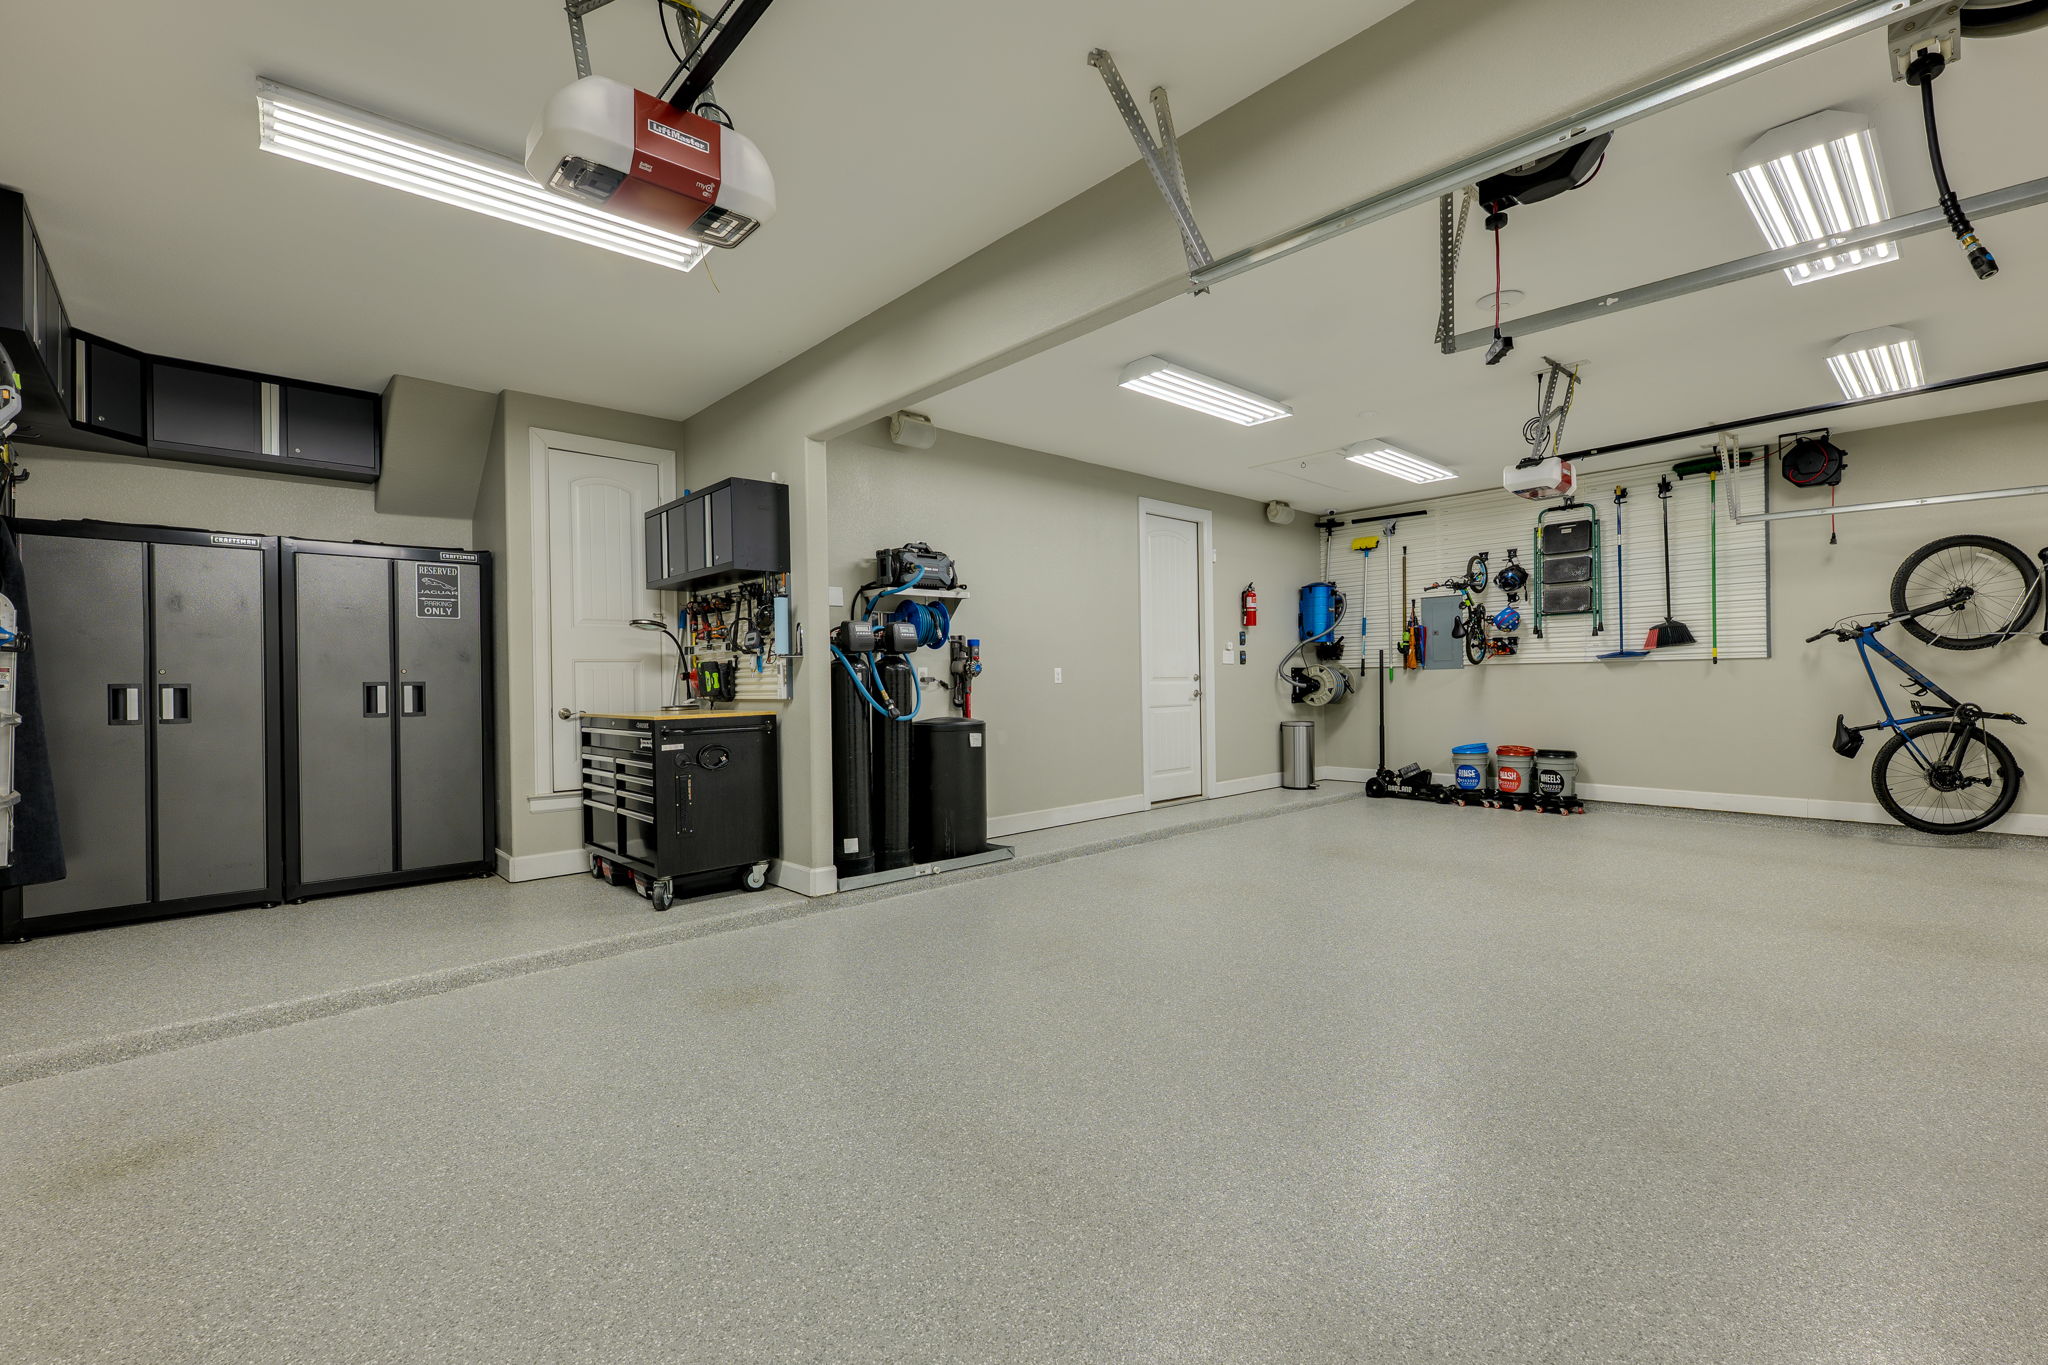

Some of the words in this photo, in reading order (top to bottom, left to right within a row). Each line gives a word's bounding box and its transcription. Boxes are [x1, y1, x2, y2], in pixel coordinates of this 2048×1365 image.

[652, 122, 706, 150] LiftMaster
[214, 537, 257, 545] CRAFTSMAN
[419, 566, 458, 576] RESERVED
[424, 600, 453, 608] PARKING
[424, 607, 452, 615] ONLY
[1458, 769, 1476, 778] RINSE
[1499, 771, 1517, 780] WASH
[1540, 773, 1561, 784] WHEELS
